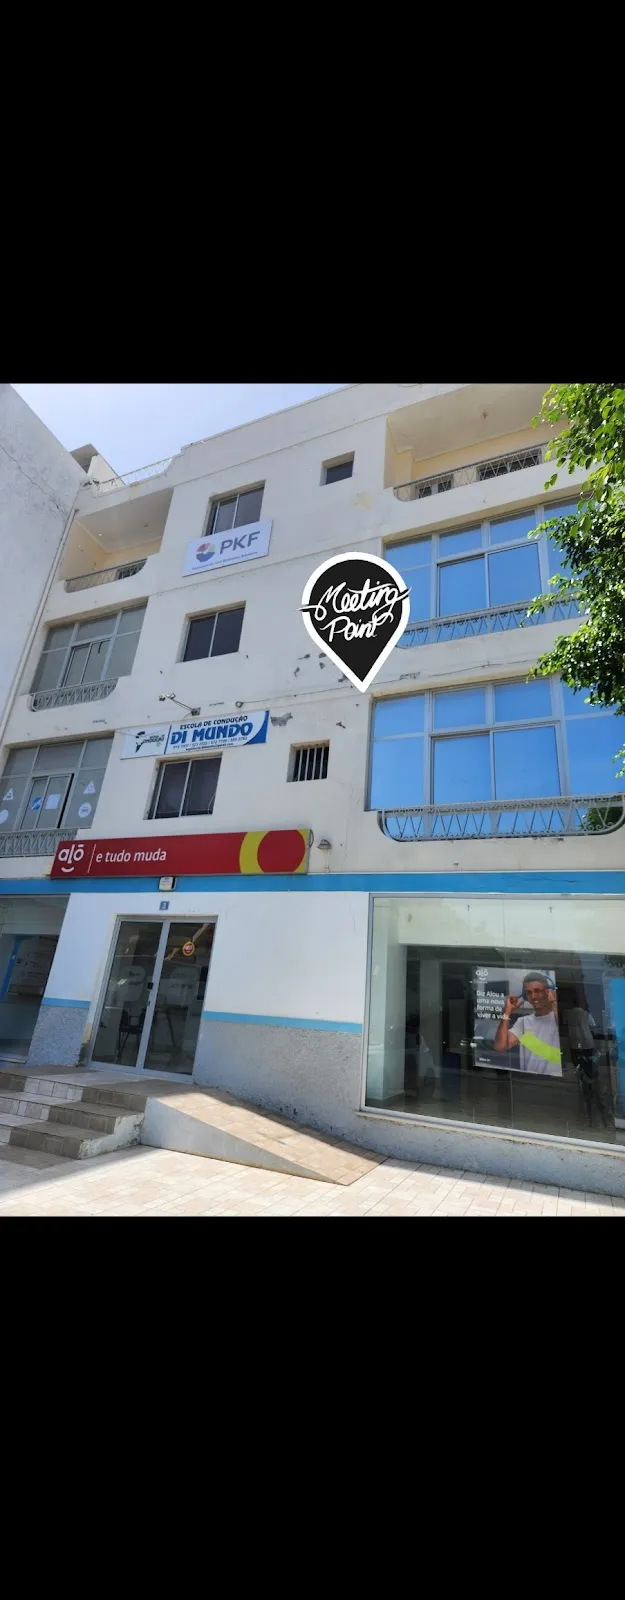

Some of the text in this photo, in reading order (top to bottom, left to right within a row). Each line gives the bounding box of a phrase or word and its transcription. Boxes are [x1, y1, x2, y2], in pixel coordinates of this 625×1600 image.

[219, 530, 261, 555] PKF
[180, 721, 202, 730] ESCOLA
[213, 715, 248, 725] CONDUÇÃO
[170, 730, 188, 745] DI
[192, 722, 254, 742] MUNDO
[95, 852, 103, 863] e
[105, 848, 131, 863] tudo
[133, 848, 167, 862] muda
